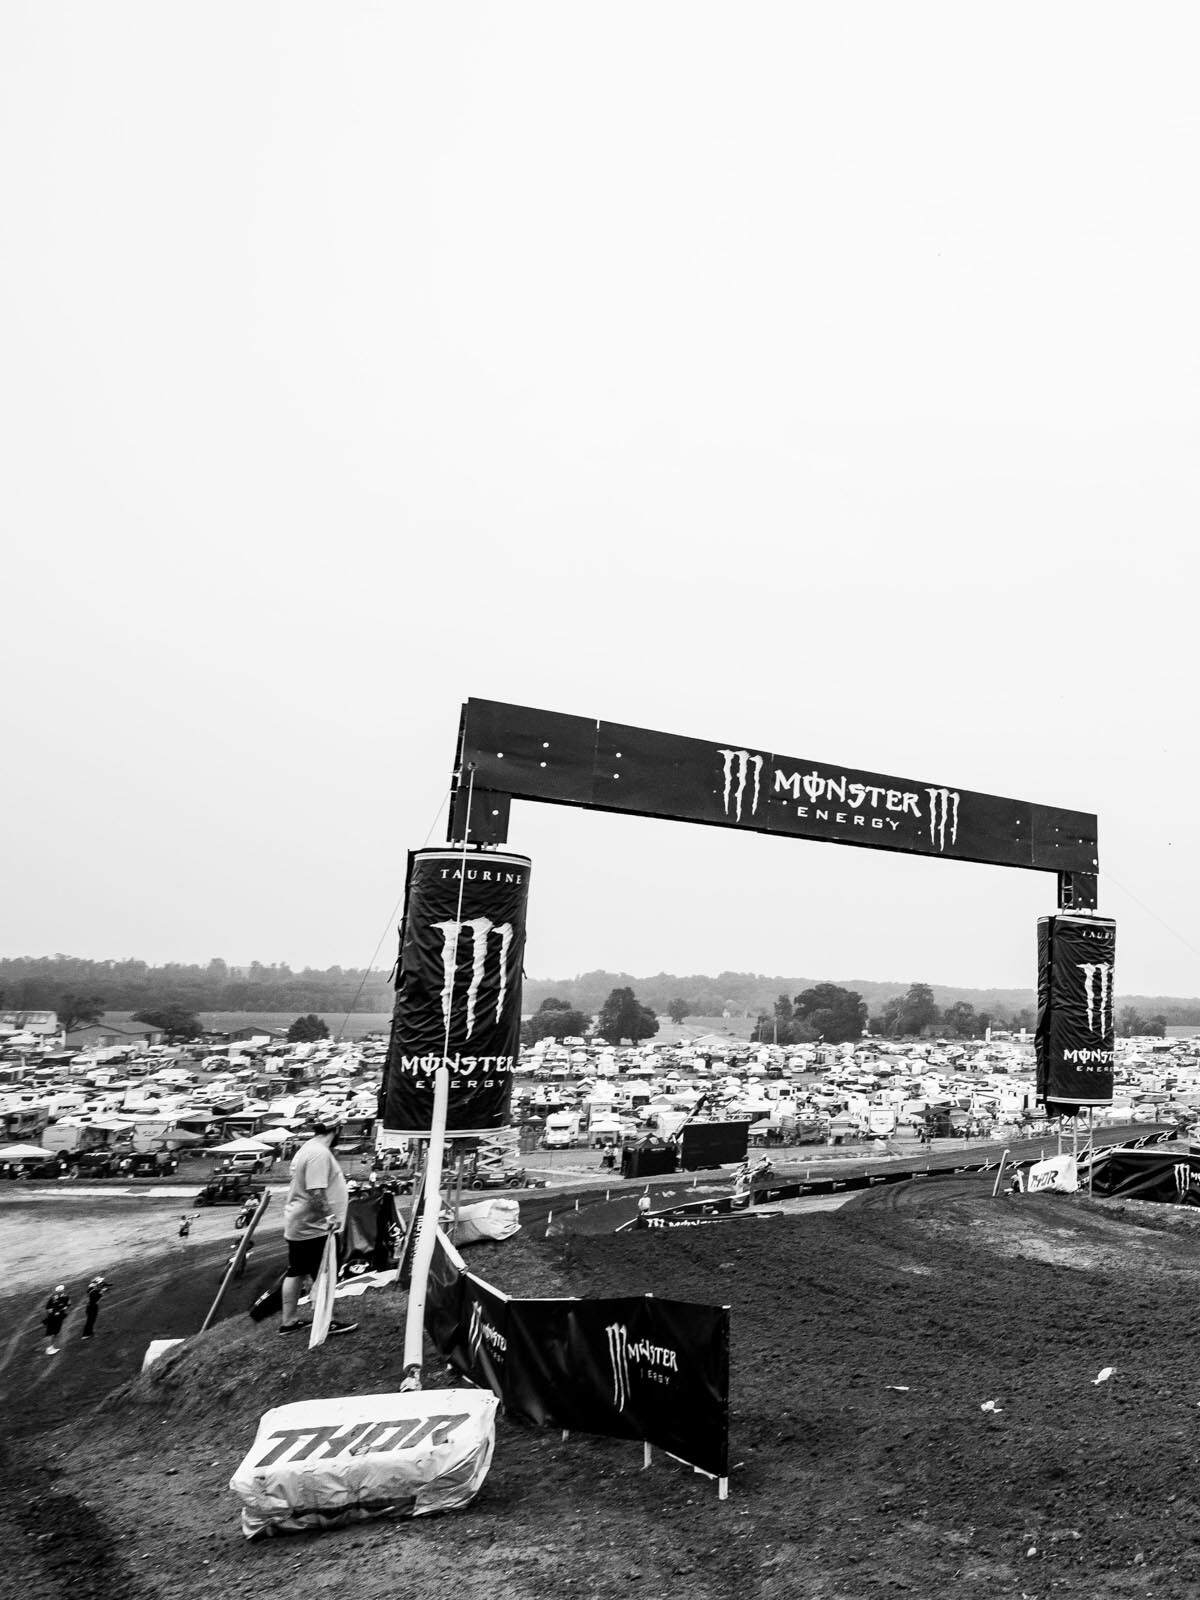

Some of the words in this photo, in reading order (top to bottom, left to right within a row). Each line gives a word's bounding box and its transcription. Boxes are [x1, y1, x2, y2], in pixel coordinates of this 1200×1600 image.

[774, 769, 922, 817] MONSTER
[797, 806, 900, 831] ENERGY
[440, 868, 523, 885] TAURINE
[416, 1080, 505, 1089] EERGY
[254, 1413, 471, 1468] THOR
